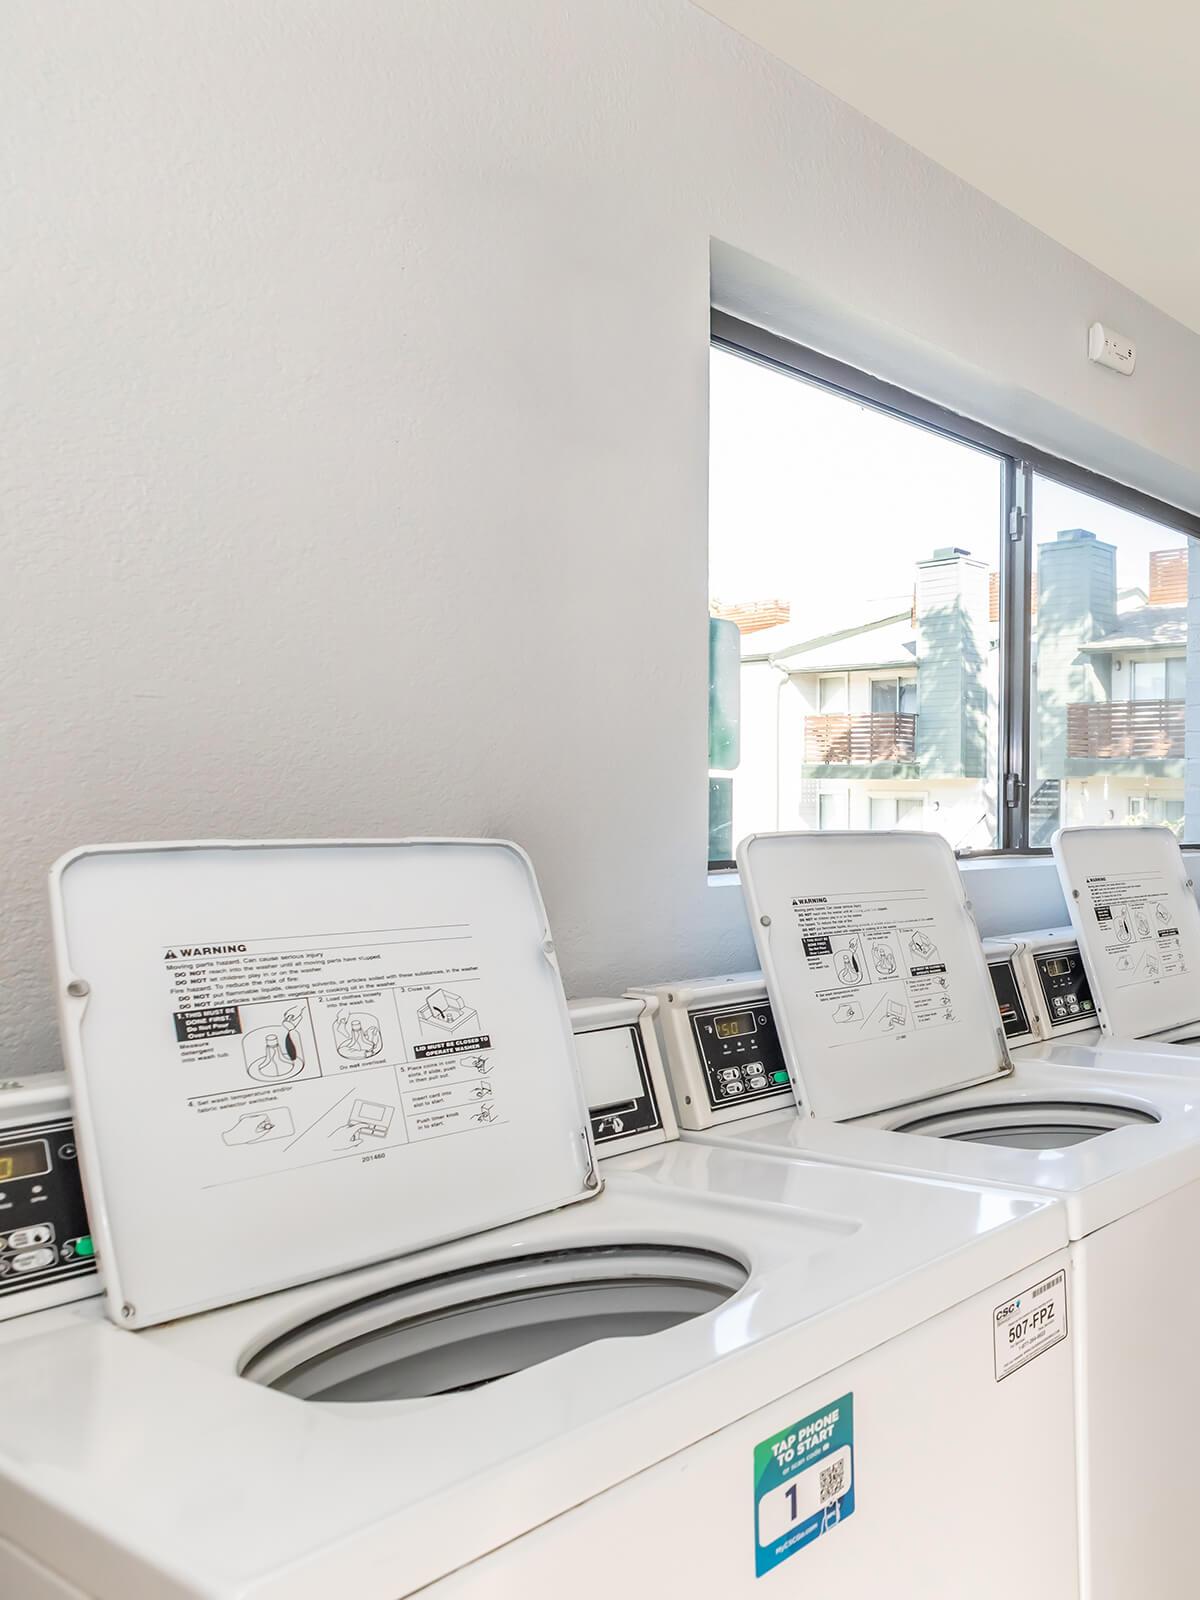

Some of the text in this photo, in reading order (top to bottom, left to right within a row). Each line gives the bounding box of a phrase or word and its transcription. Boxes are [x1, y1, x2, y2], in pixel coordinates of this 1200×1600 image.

[179, 944, 247, 957] WARNING
[194, 961, 214, 969] parts
[192, 992, 210, 1000] NOT
[225, 988, 259, 996] flammable
[193, 1000, 211, 1008] NOT
[202, 1008, 224, 1016] MUST
[185, 1017, 207, 1026] DONE
[178, 1041, 209, 1049] Measure
[425, 1043, 480, 1056] OPERATE WASHER
[426, 1042, 444, 1050] MUST
[455, 1037, 479, 1045] CLOSED
[180, 1047, 214, 1056] detergent
[230, 1089, 271, 1100] temperature
[219, 1101, 247, 1109] selector
[996, 1304, 1015, 1321] CSC
[1008, 1302, 1055, 1343] 507-FPZ
[772, 1408, 840, 1456] TAP PHONE
[777, 1424, 834, 1466] TO START
[806, 1448, 821, 1462] code
[785, 1483, 797, 1520] 1
